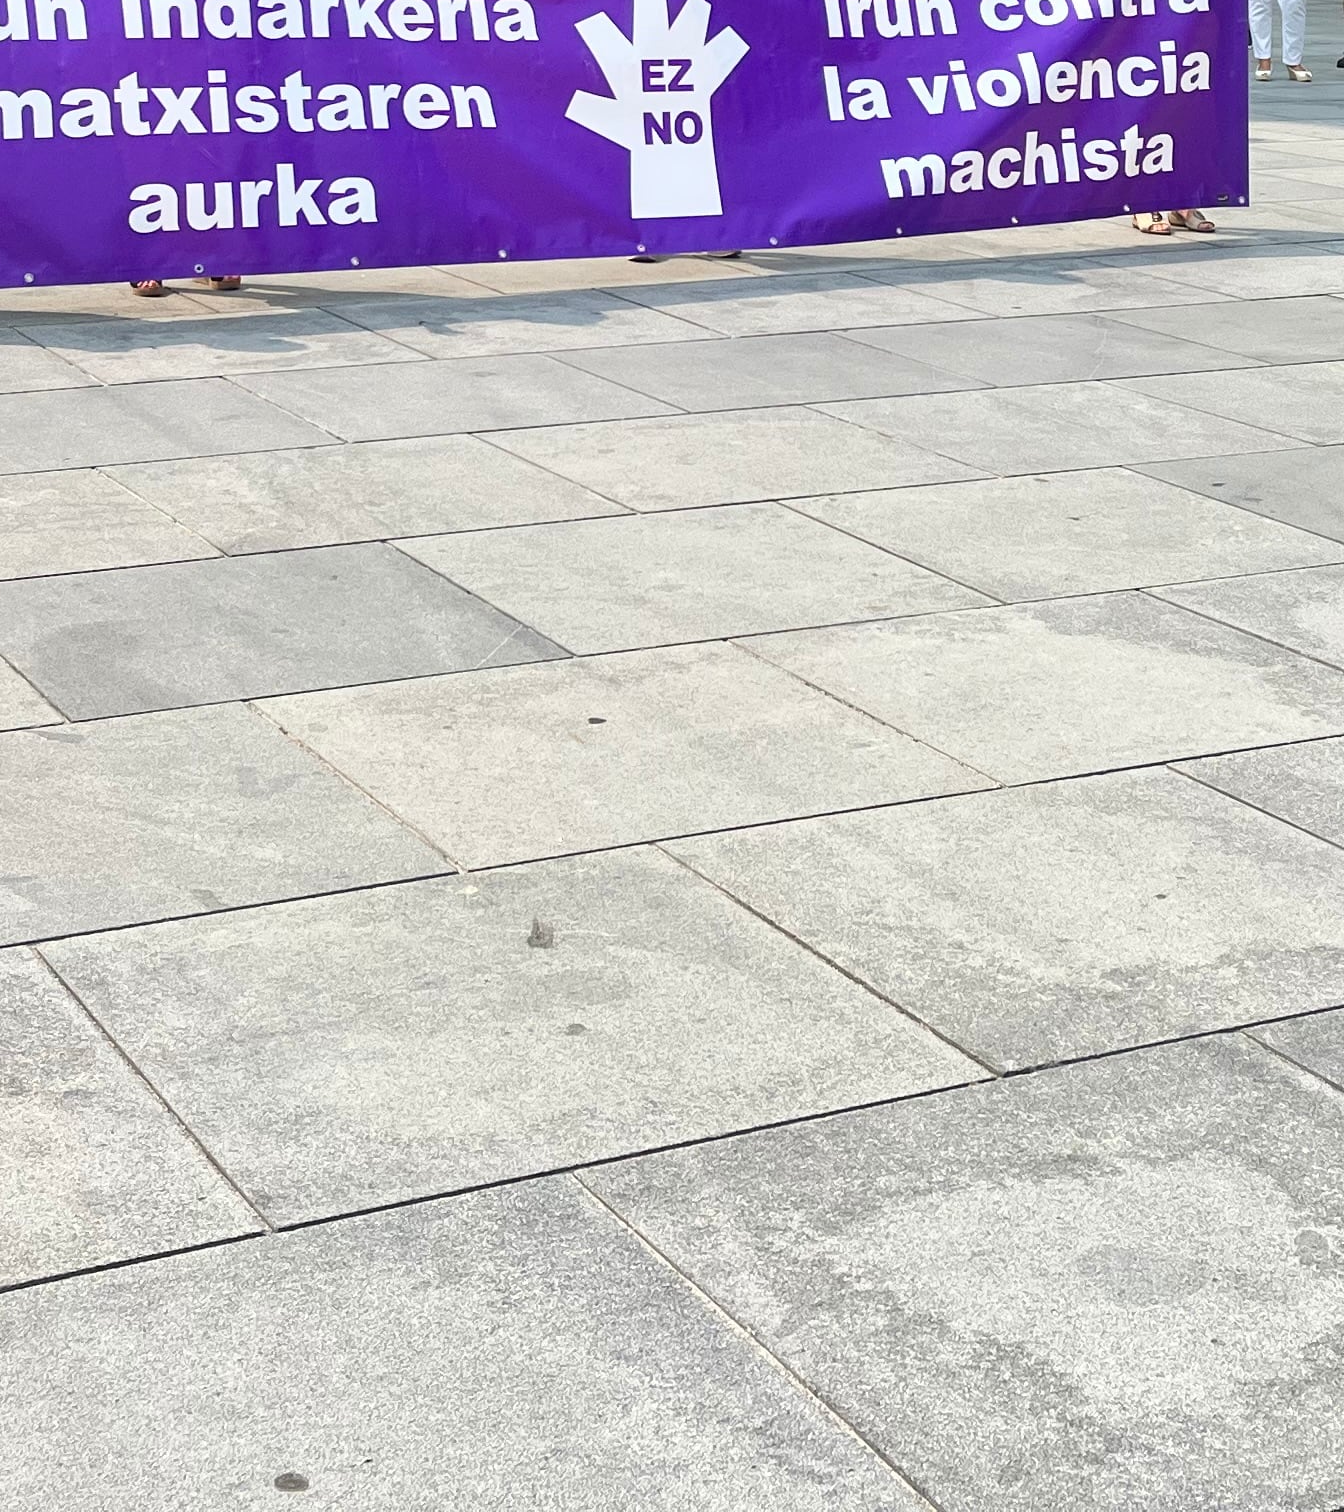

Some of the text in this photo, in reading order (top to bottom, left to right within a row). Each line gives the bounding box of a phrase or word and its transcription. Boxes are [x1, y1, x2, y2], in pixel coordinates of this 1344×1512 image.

[641, 59, 694, 93] EZ
[822, 40, 1211, 121] la violencia
[643, 111, 704, 145] NO
[880, 123, 1174, 199] machista
[128, 162, 379, 234] aurka
